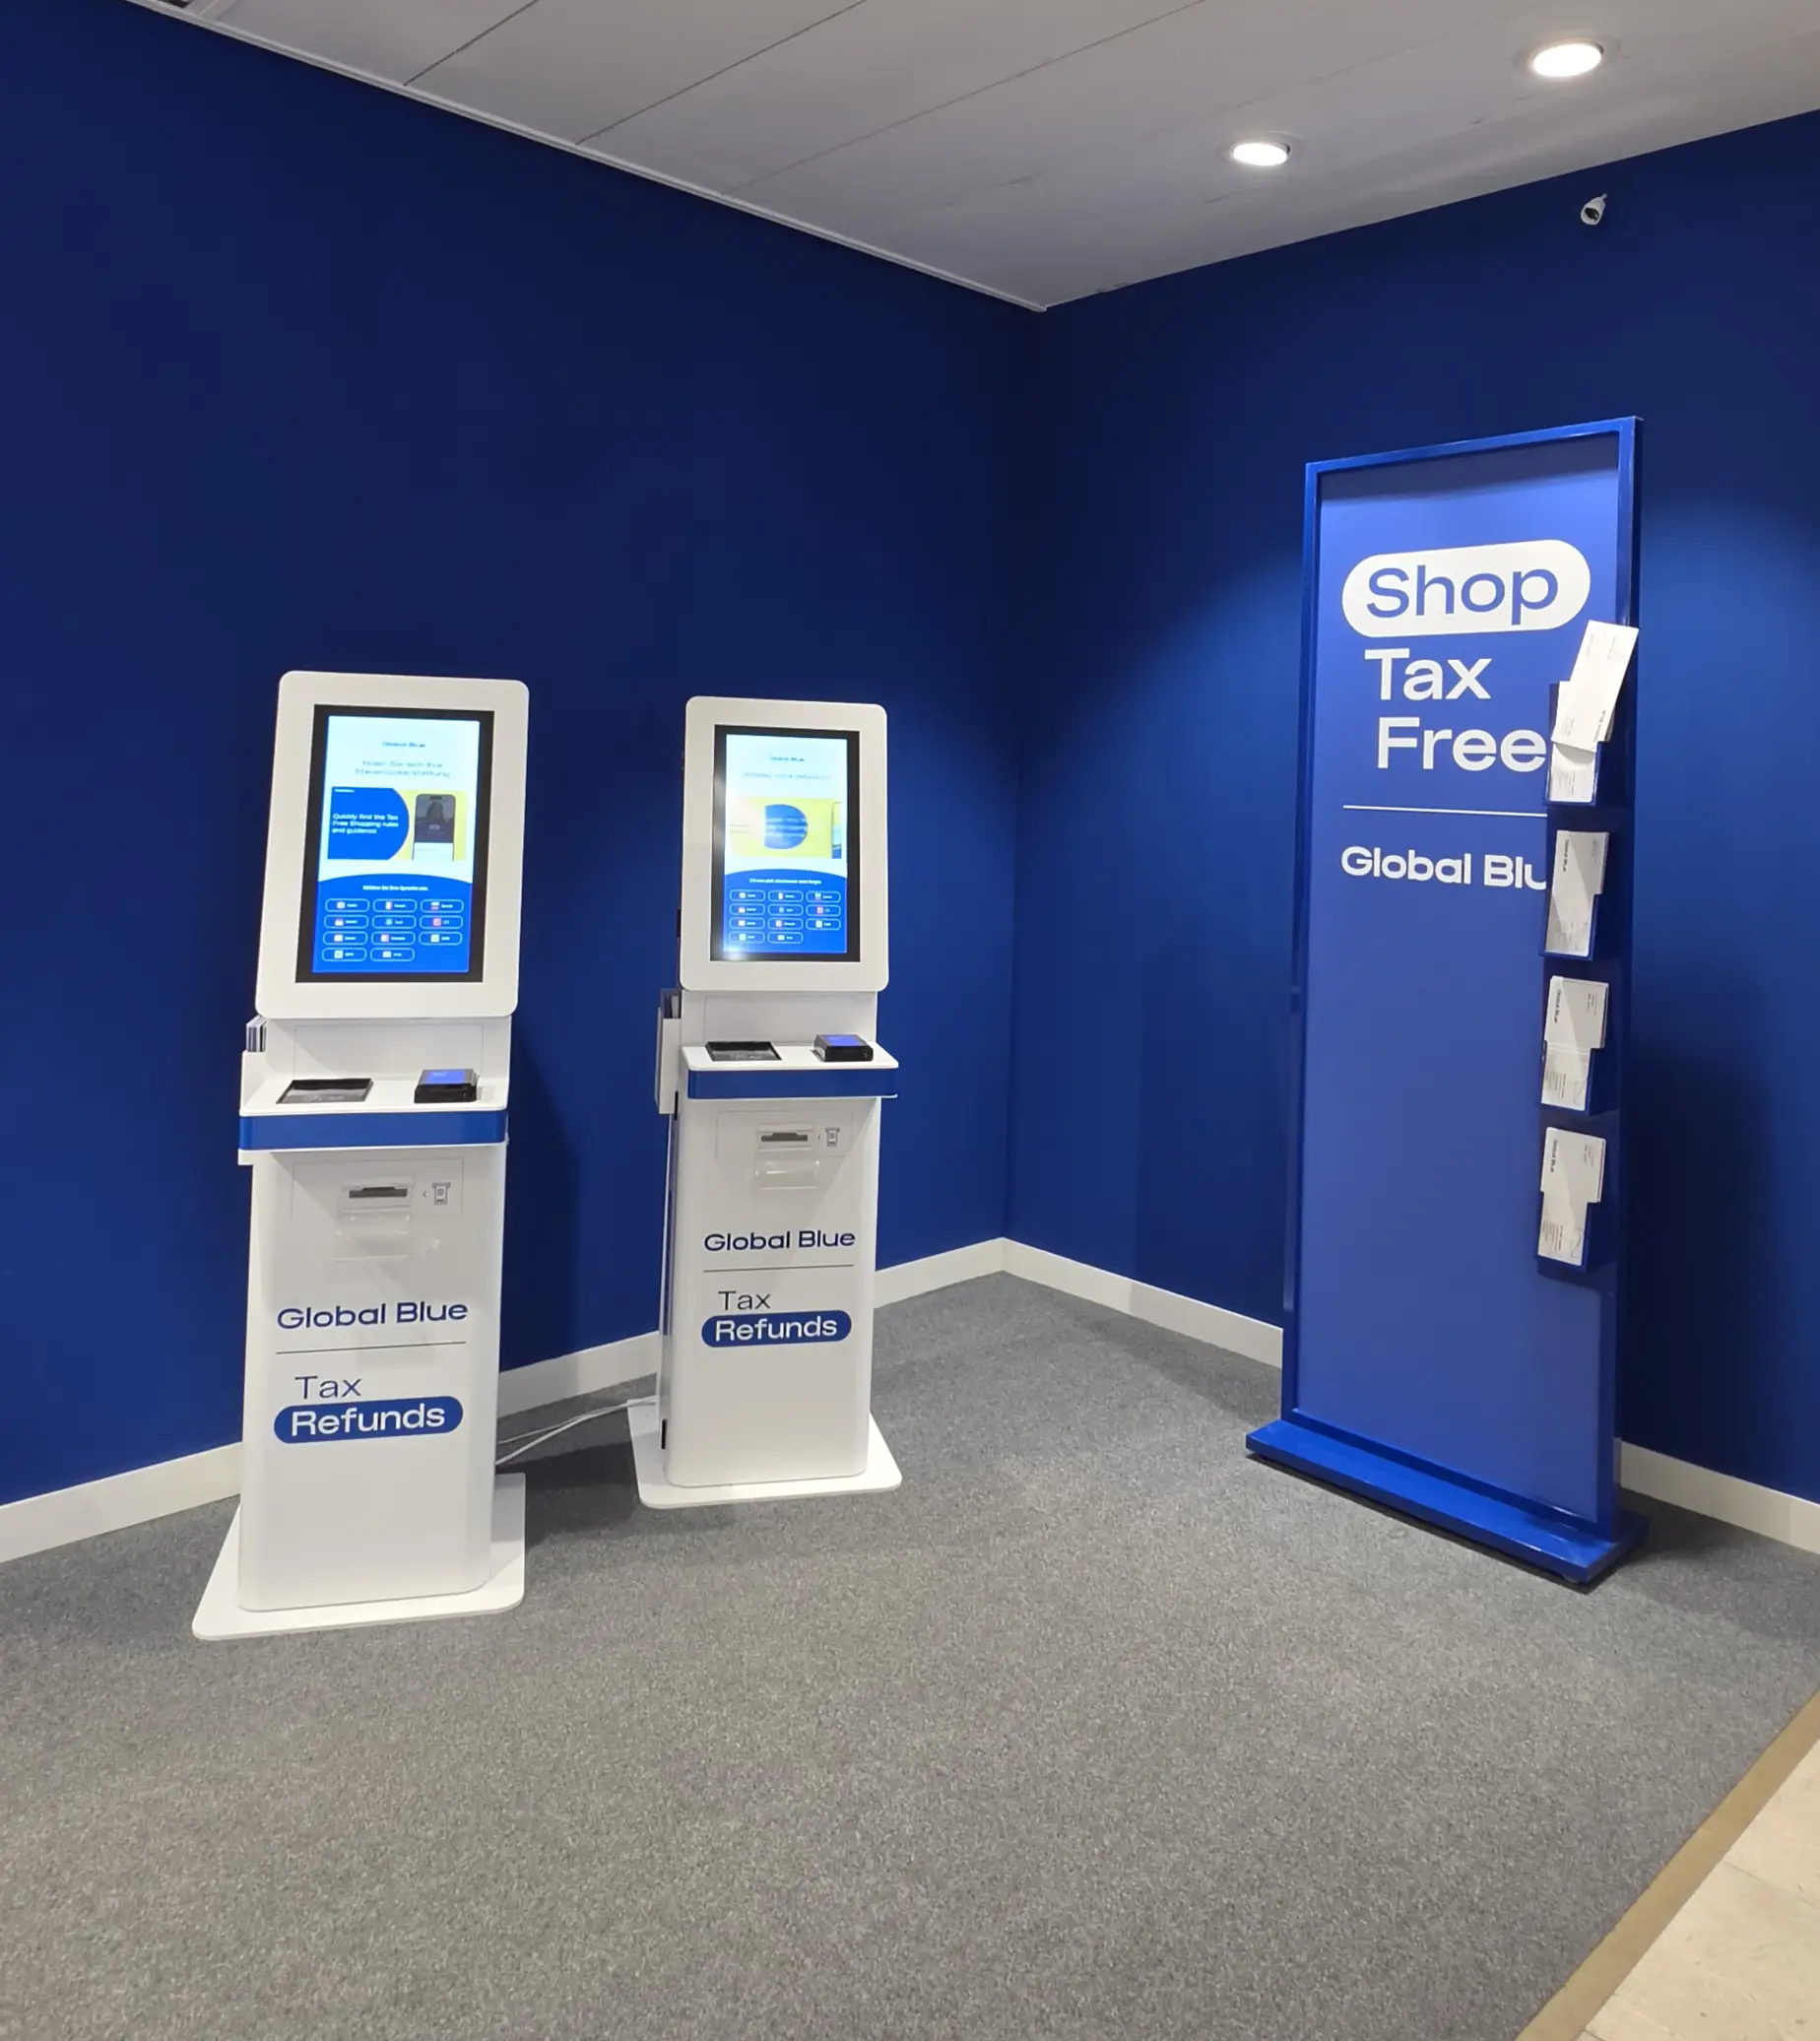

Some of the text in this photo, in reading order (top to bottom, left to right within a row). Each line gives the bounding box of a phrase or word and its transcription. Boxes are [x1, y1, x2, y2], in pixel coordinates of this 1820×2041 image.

[1366, 564, 1559, 625] Shop
[1364, 647, 1492, 700] Tax
[1377, 716, 1547, 772] Free
[1341, 846, 1471, 885] Global
[1484, 854, 1547, 890] Blu
[704, 1230, 856, 1252] Global Blue
[277, 1301, 468, 1330] Global Blue
[718, 1290, 771, 1310] Tax
[715, 1316, 838, 1343] Refunds
[294, 1375, 362, 1399] Tax
[292, 1403, 445, 1436] Refunds
